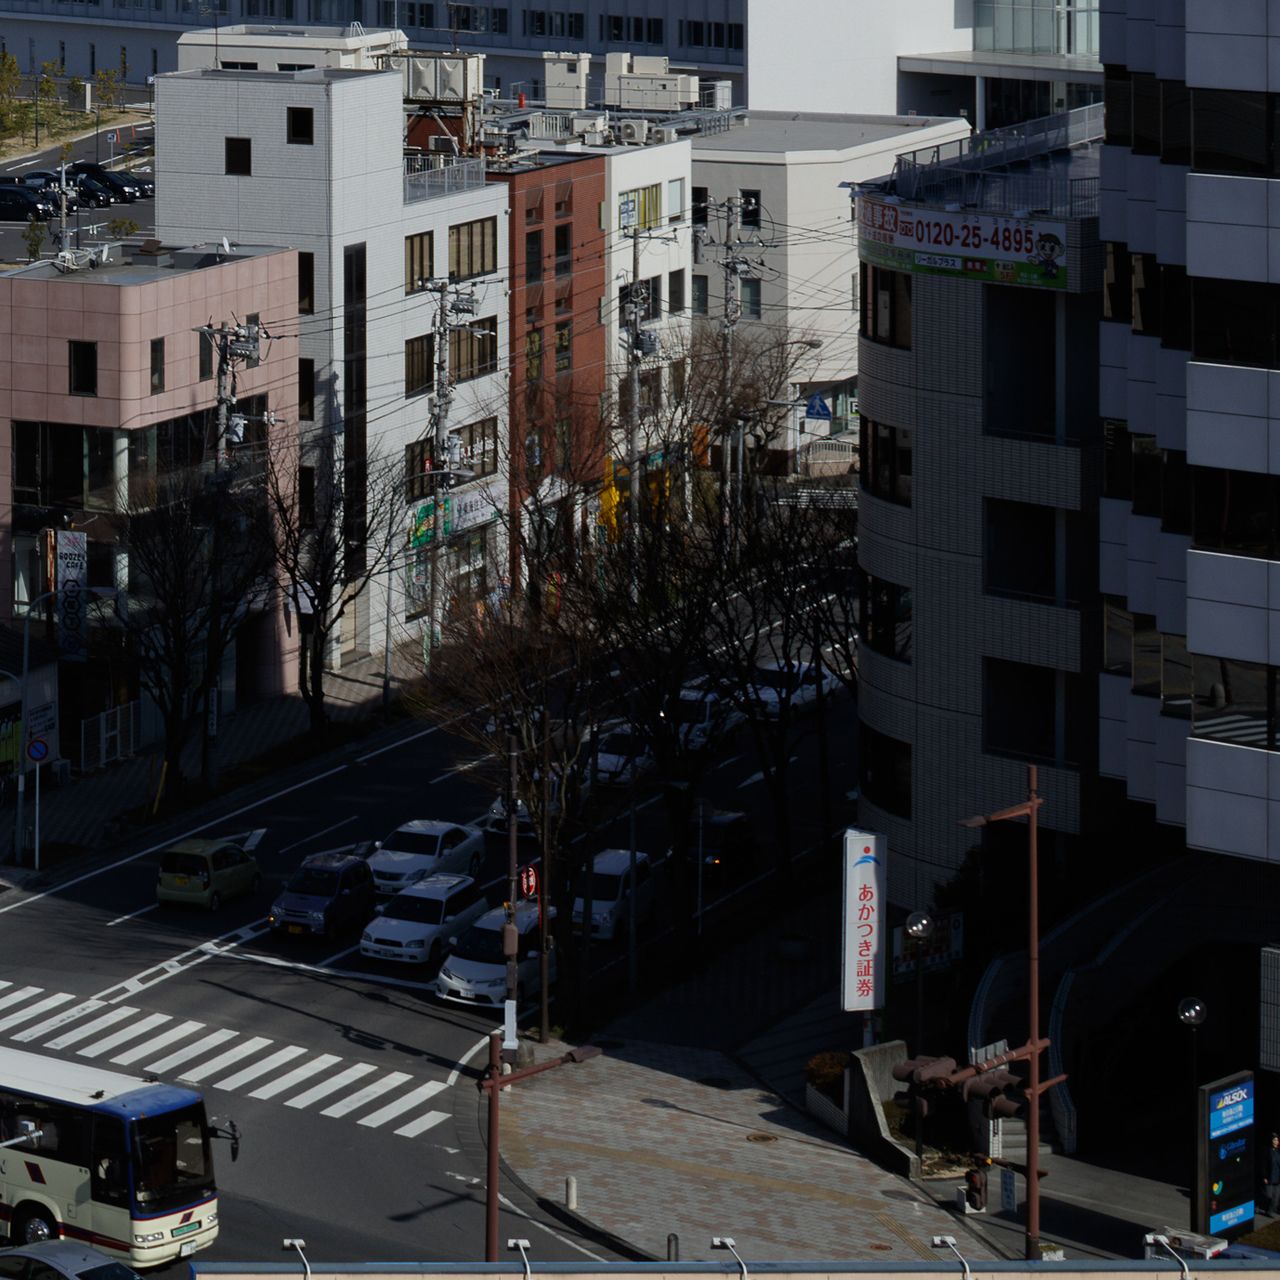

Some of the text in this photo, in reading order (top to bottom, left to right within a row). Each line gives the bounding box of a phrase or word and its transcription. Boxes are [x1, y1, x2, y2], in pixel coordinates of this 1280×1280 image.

[915, 219, 1034, 254] 0120-25-4895
[856, 884, 874, 997] あかつき証券
